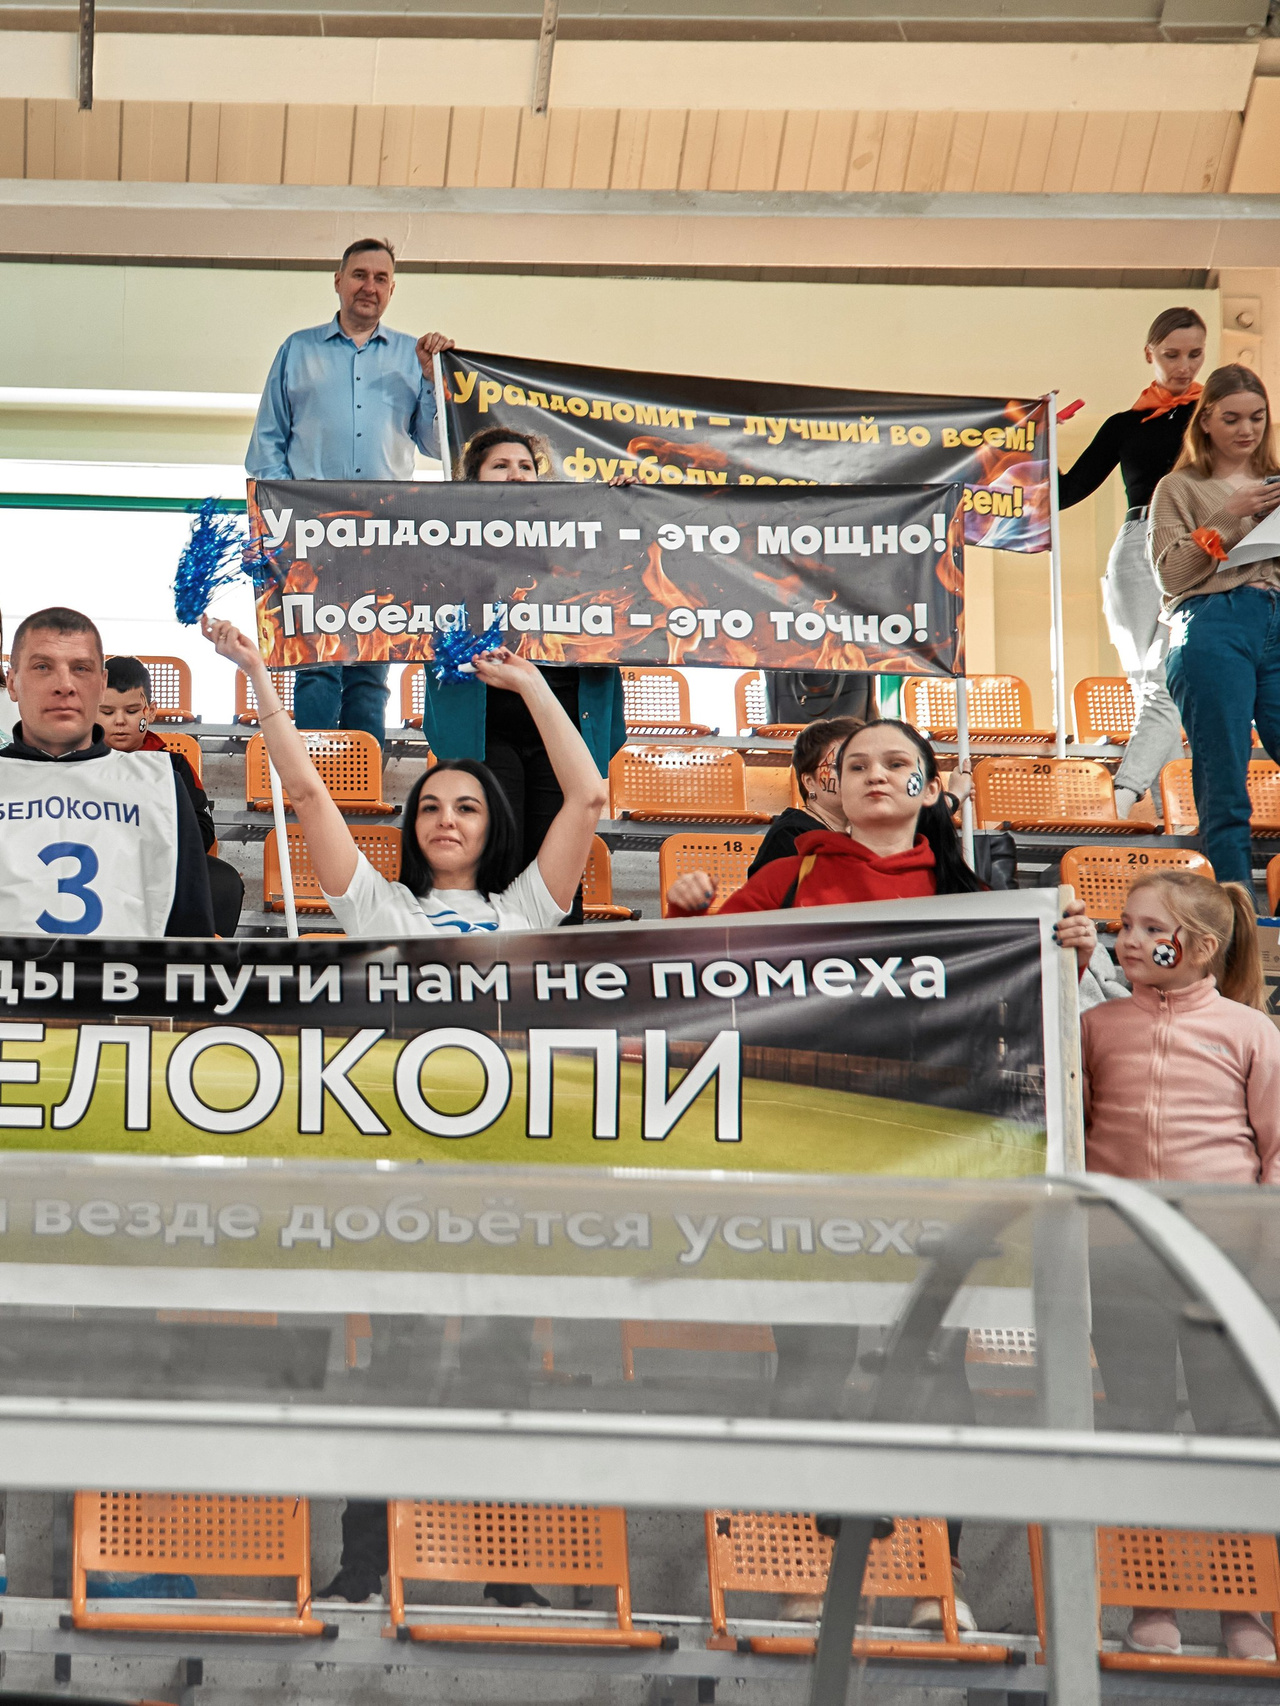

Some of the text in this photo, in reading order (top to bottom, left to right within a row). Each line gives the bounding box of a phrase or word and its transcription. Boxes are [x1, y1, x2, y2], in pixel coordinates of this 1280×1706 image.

[452, 371, 697, 430] Уралдоломит
[742, 415, 880, 445] лучший
[889, 424, 931, 448] во
[941, 420, 1036, 452] всем!
[261, 508, 602, 559] Уралдоломит
[657, 522, 741, 555] это
[757, 512, 948, 557] мощно!
[280, 594, 468, 637] Победа
[482, 601, 613, 635] наша
[668, 606, 754, 640] это
[769, 602, 929, 645] точно!
[1032, 763, 1052, 775] 20
[723, 840, 743, 852] 18
[1128, 852, 1150, 865] 20
[35, 841, 104, 935] 3
[102, 960, 140, 1002] в
[165, 962, 342, 1015] пути
[367, 960, 510, 1003] нам
[534, 960, 629, 1001] не
[651, 954, 947, 1001] помеха
[33, 1196, 261, 1247] везде
[280, 1194, 652, 1252] добьётся
